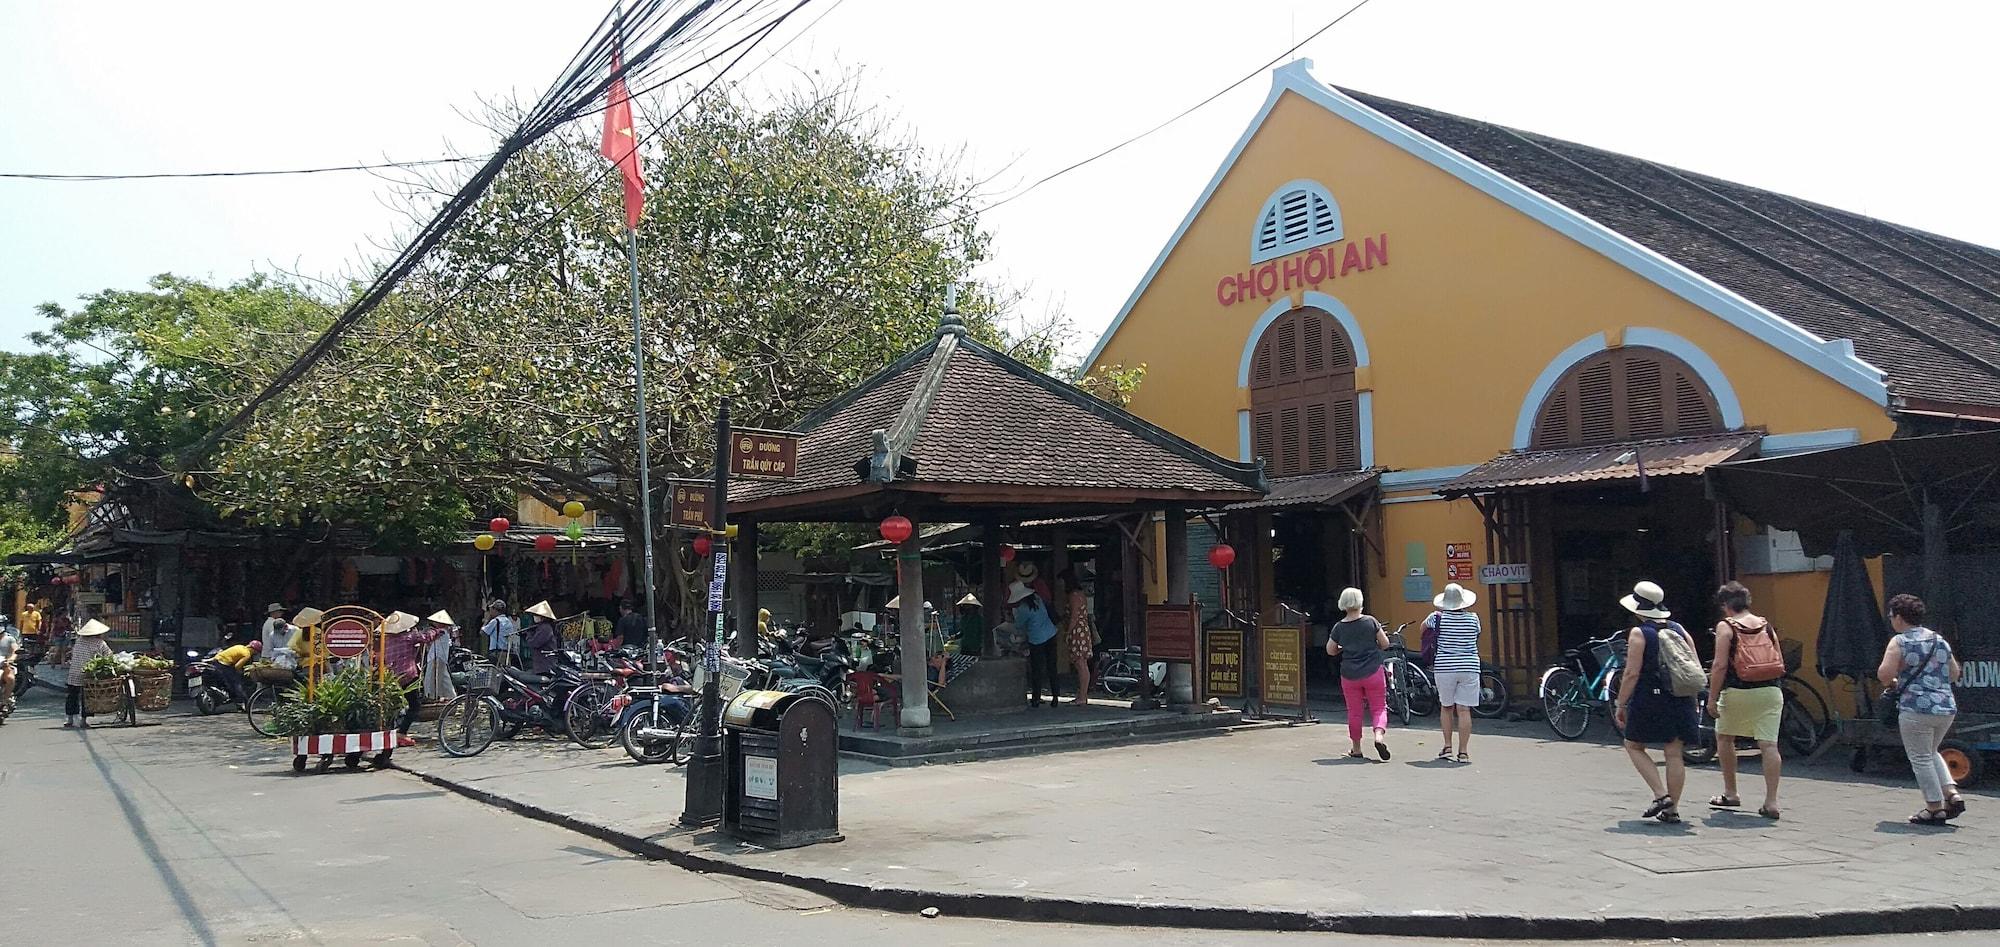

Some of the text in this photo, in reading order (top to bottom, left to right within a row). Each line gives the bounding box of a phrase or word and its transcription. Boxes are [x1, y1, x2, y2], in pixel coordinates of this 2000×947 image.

[1217, 233, 1388, 306] CHỢ HỘI AN
[759, 441, 781, 453] ĐƯỜNG
[742, 456, 759, 470] TRẦN
[1211, 652, 1239, 668] KHU VỰC
[1231, 672, 1238, 681] XE
